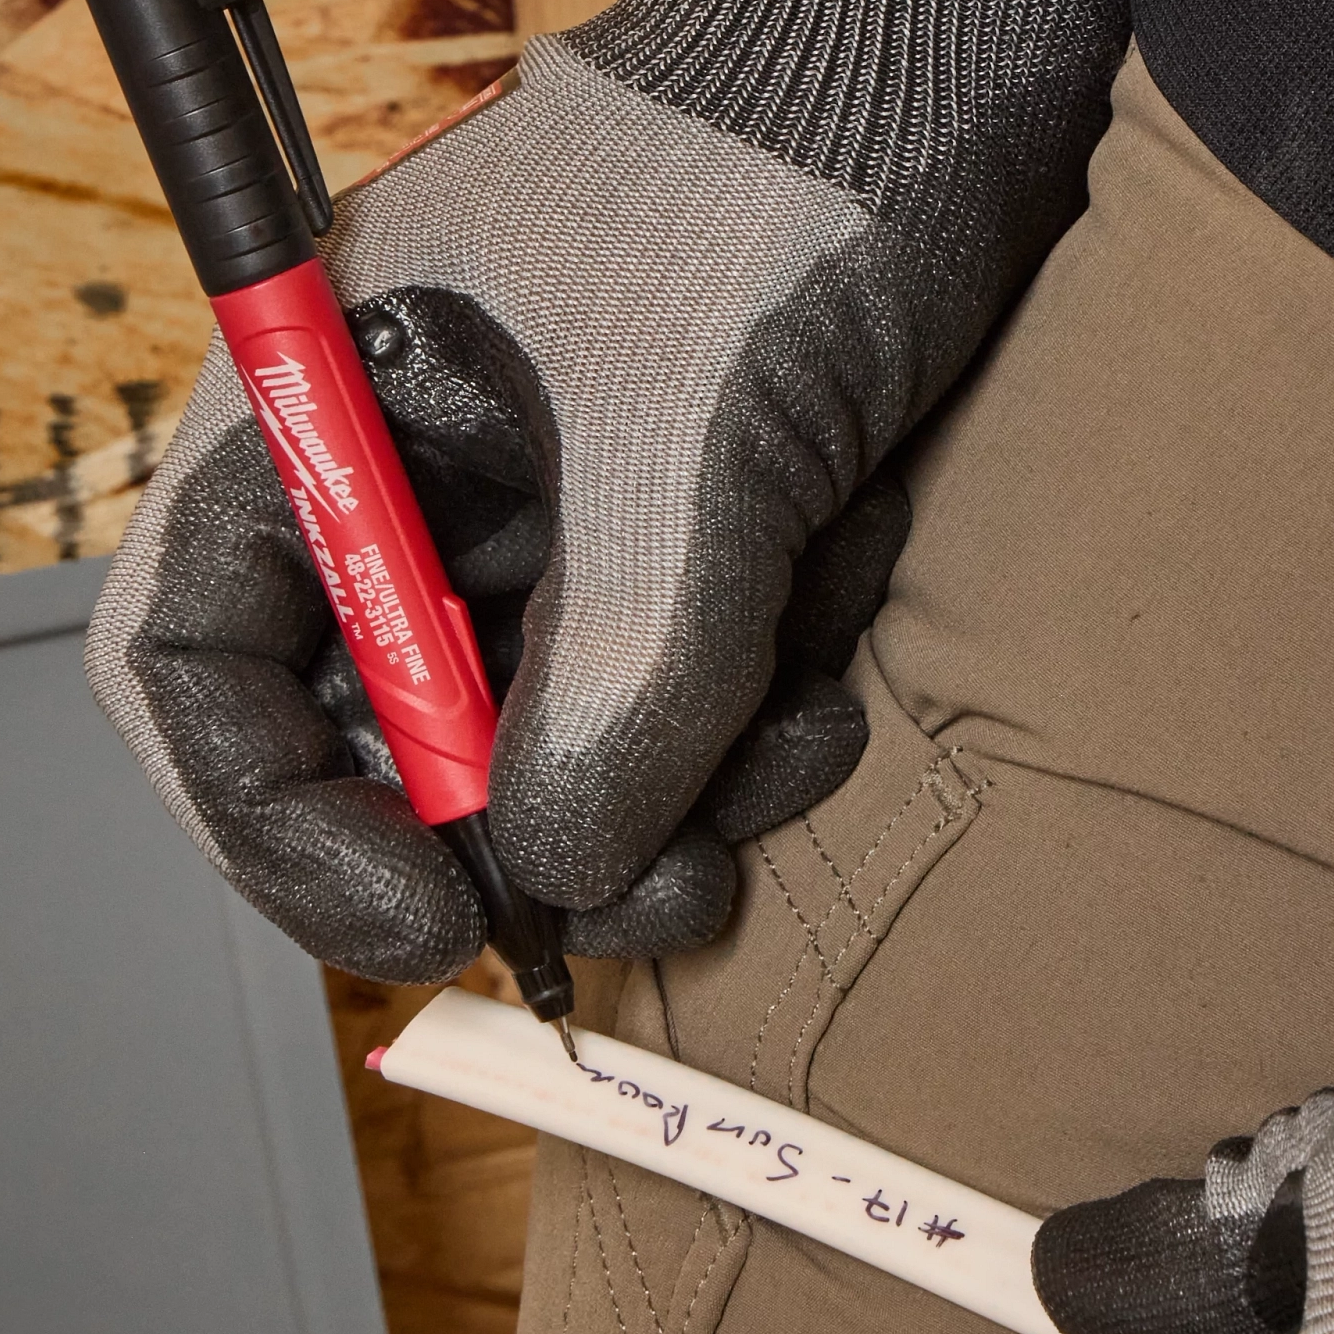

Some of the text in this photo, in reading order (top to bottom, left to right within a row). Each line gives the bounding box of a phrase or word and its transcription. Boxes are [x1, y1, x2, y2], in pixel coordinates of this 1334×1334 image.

[254, 351, 359, 515] Milwaukee
[344, 554, 400, 665] 48-22-3115 5S
[360, 543, 431, 686] FINE/ULTRA FINE
